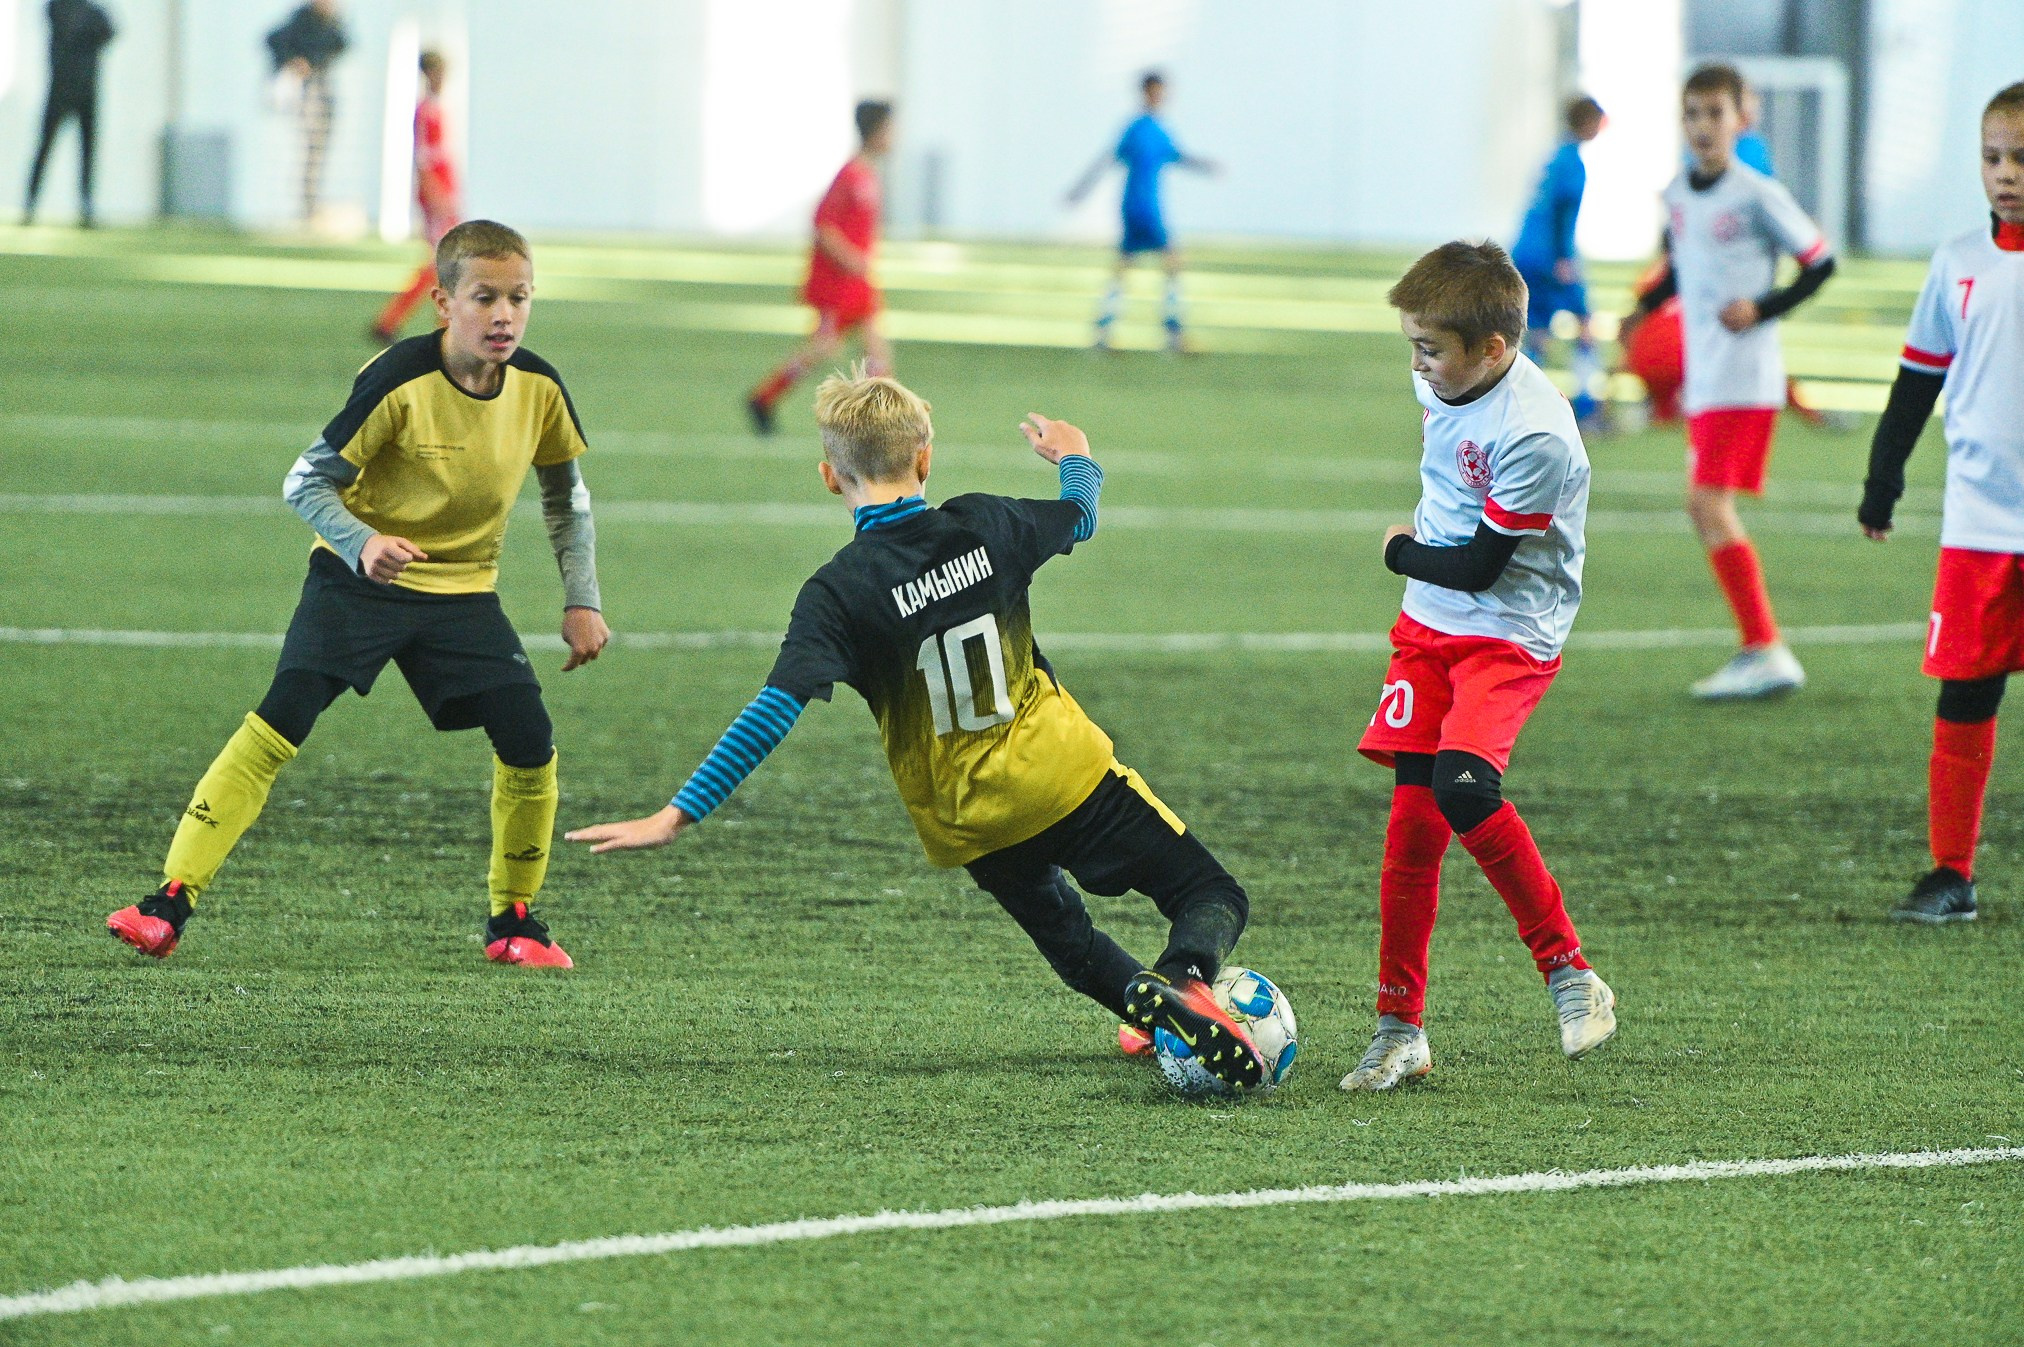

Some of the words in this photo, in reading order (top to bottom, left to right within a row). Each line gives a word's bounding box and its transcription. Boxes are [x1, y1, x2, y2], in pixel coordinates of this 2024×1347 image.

[1957, 276, 1976, 320] 7
[891, 546, 994, 619] КАМЫНИН
[916, 612, 1016, 736] 10
[187, 807, 220, 829] EMIX
